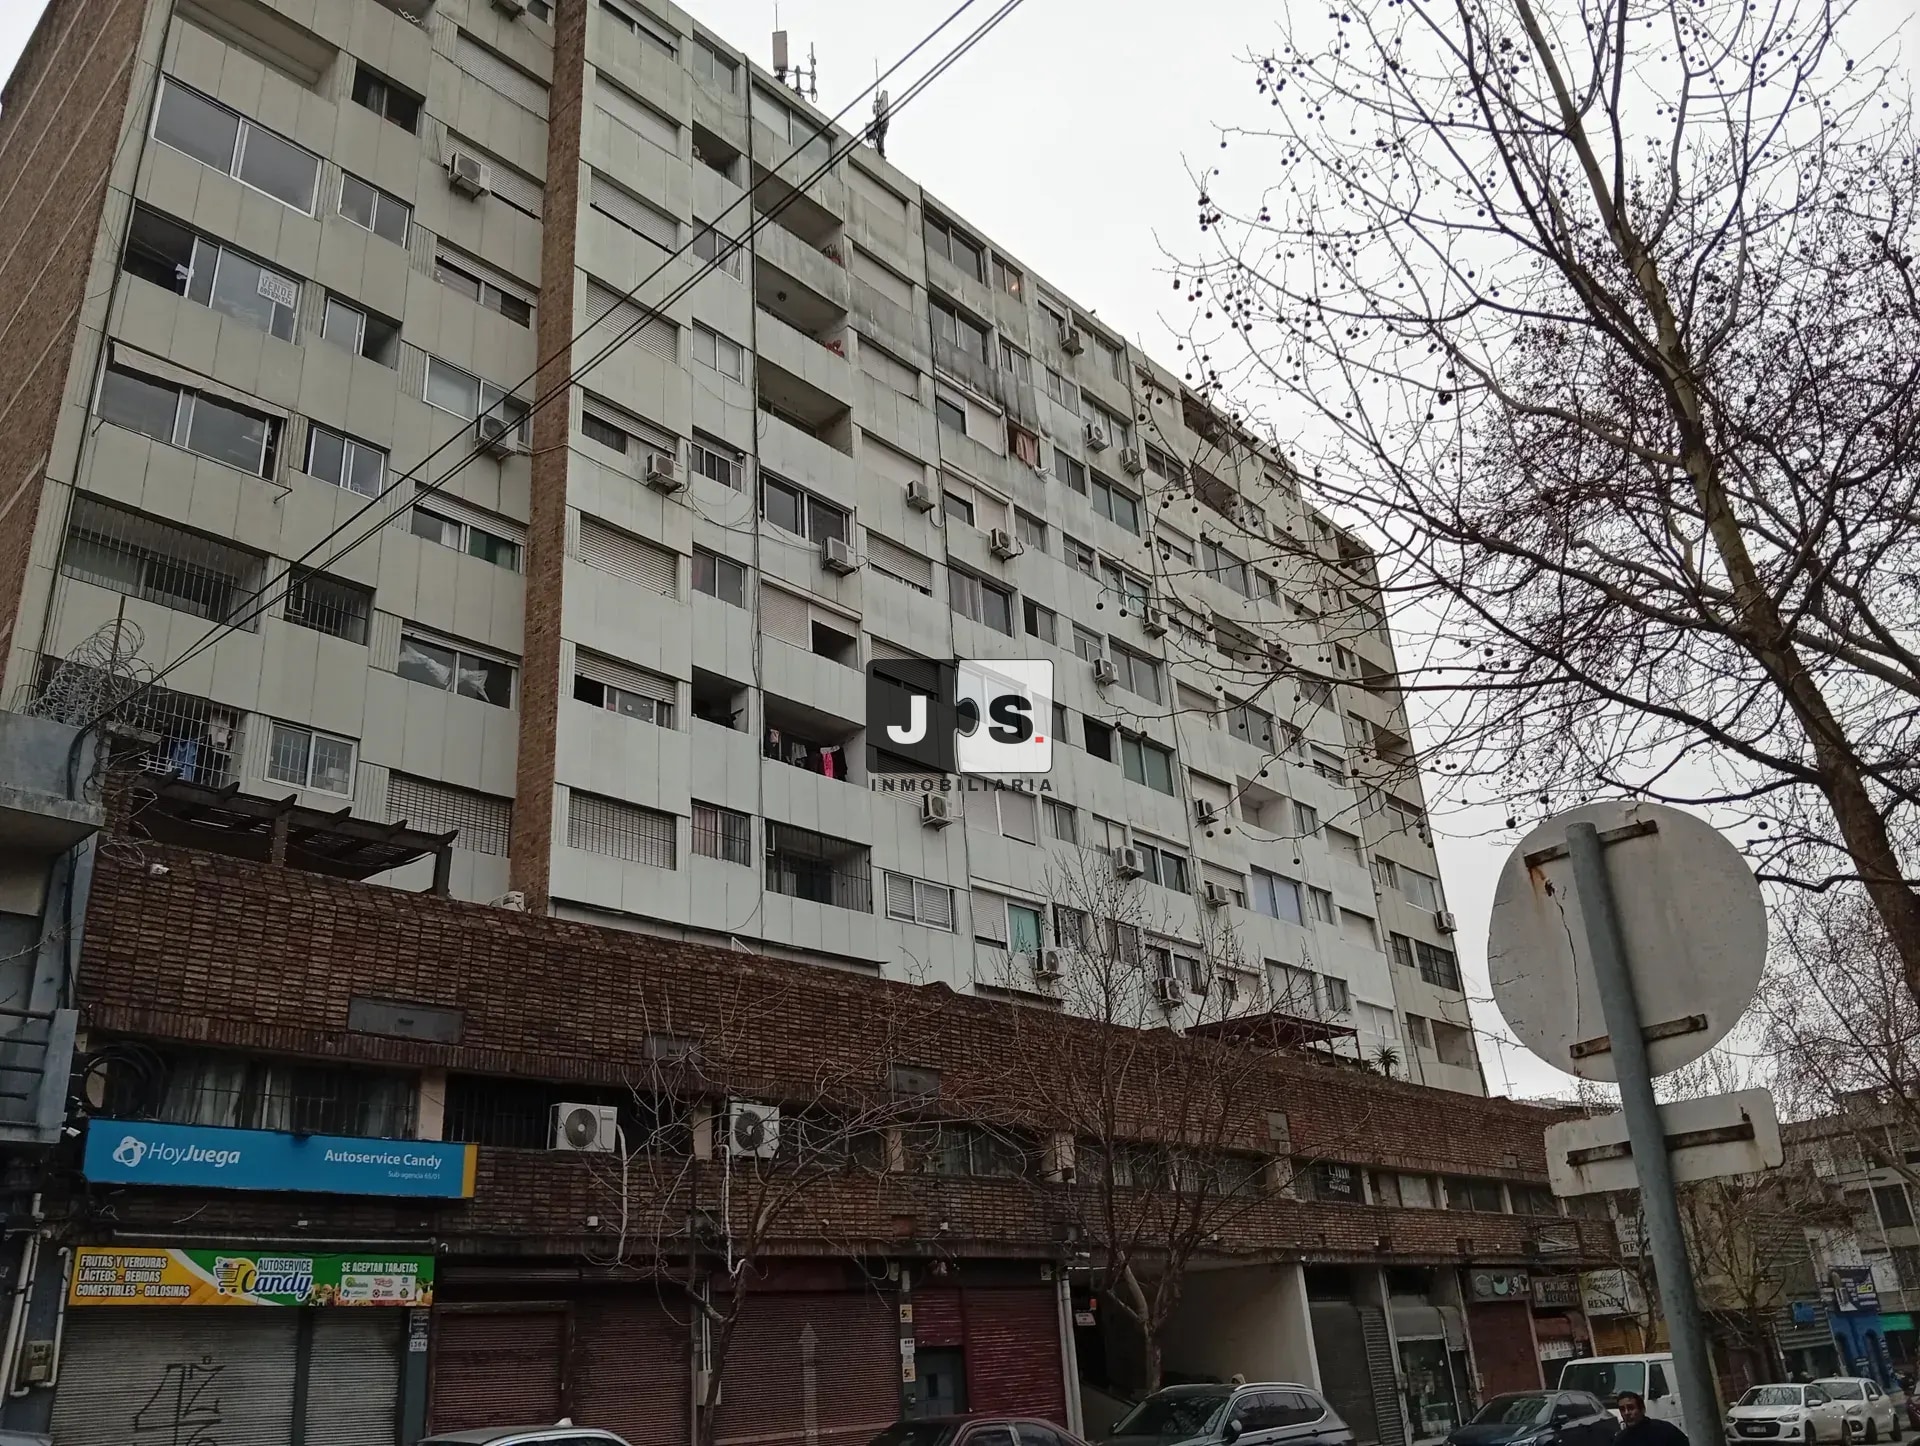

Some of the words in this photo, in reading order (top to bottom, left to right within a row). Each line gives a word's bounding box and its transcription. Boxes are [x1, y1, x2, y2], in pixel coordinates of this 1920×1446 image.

[262, 277, 293, 300] VENDE
[148, 1142, 241, 1168] HoyJuega
[324, 1149, 401, 1166] Autoservice
[403, 1153, 442, 1170] Candy
[80, 1255, 114, 1267] FRUTAS
[116, 1256, 123, 1267] Y
[123, 1256, 168, 1269] VERDURAS
[258, 1259, 312, 1271] AUTOSERVICE
[341, 1262, 351, 1272] SE
[352, 1262, 383, 1273] ACEPTAN
[384, 1263, 418, 1273] TARJETAS
[78, 1267, 117, 1281] LÁCTEOS
[124, 1270, 161, 1282] BEBIDAS
[76, 1284, 136, 1296] COMESTIBLES
[144, 1285, 191, 1297] GOLOSINAS
[241, 1269, 313, 1300] Candy
